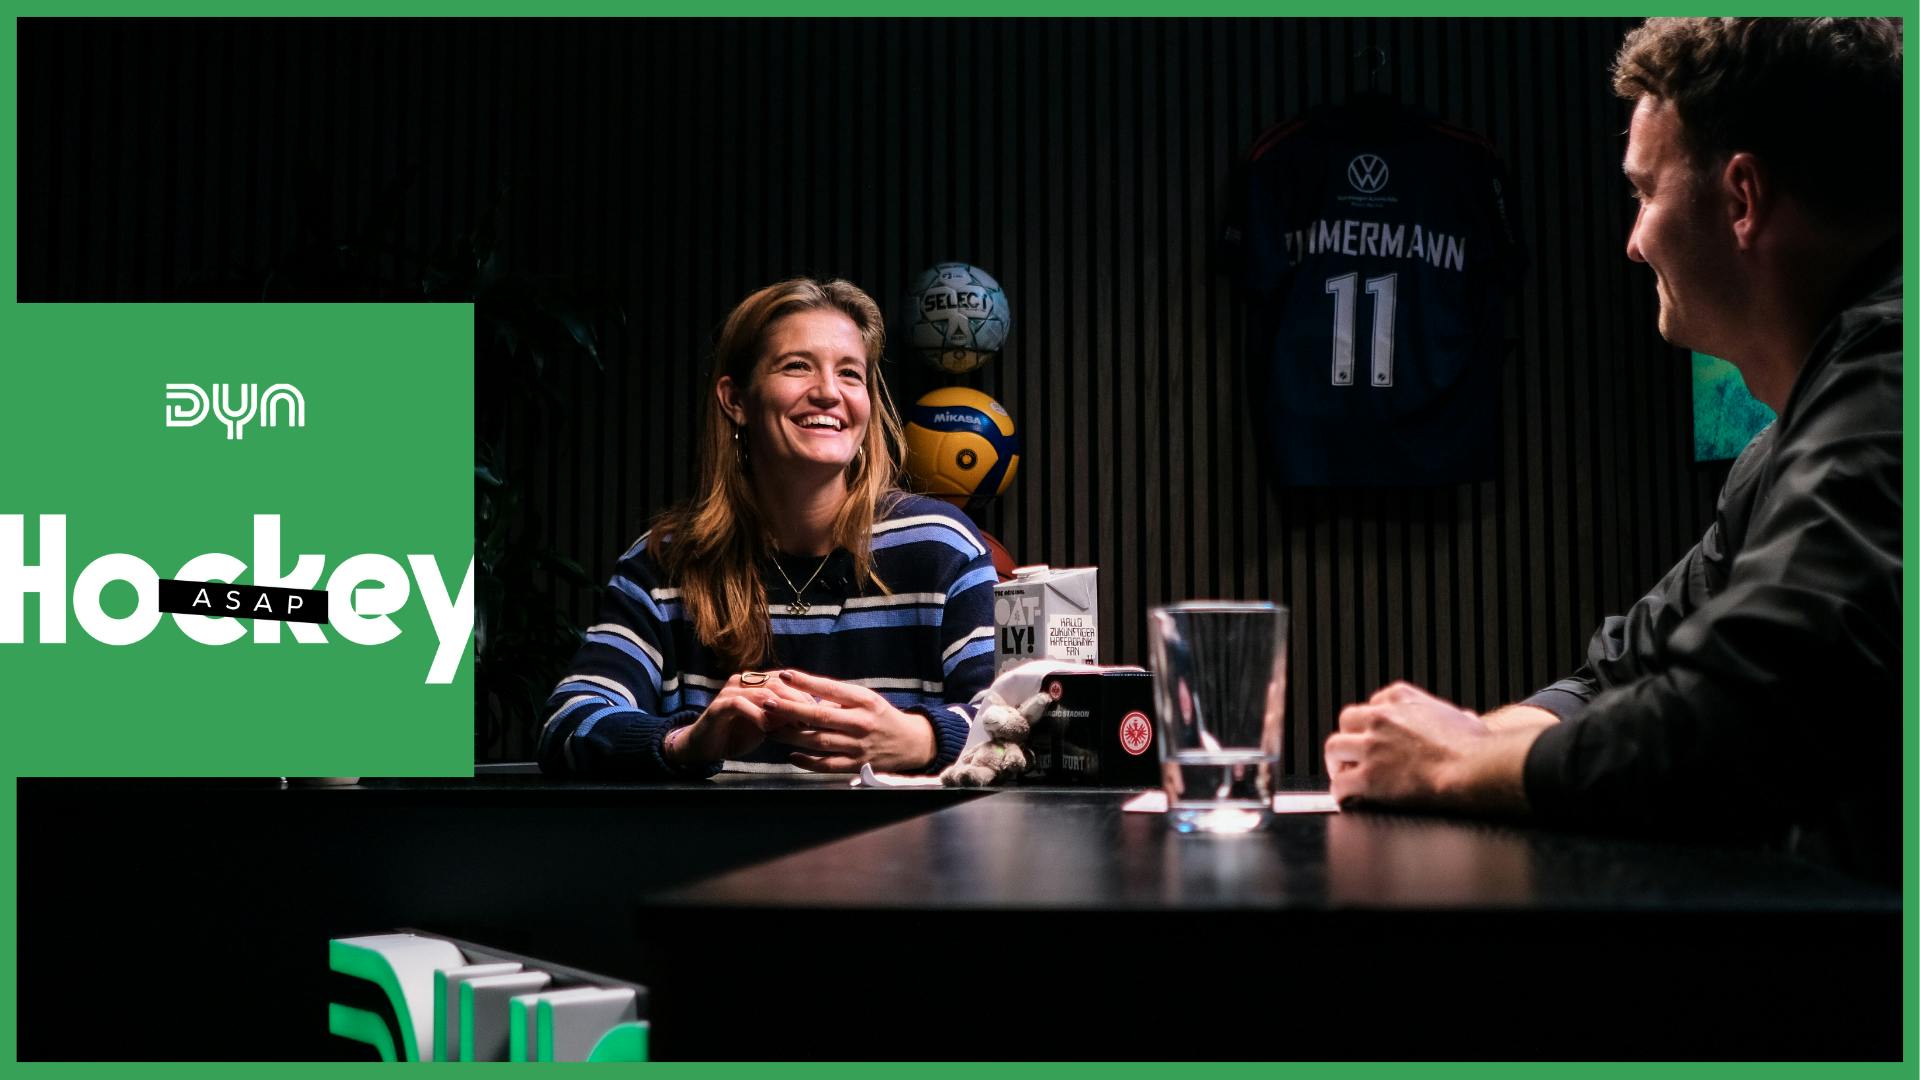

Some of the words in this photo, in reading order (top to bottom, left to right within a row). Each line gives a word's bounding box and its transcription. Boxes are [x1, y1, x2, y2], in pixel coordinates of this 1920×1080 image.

[924, 292, 988, 312] SELECT
[1325, 271, 1398, 387] 11
[994, 597, 1041, 626] OAT-
[1060, 617, 1083, 628] HALLO
[1001, 626, 1035, 655] LY!
[1066, 646, 1080, 657] FAN
